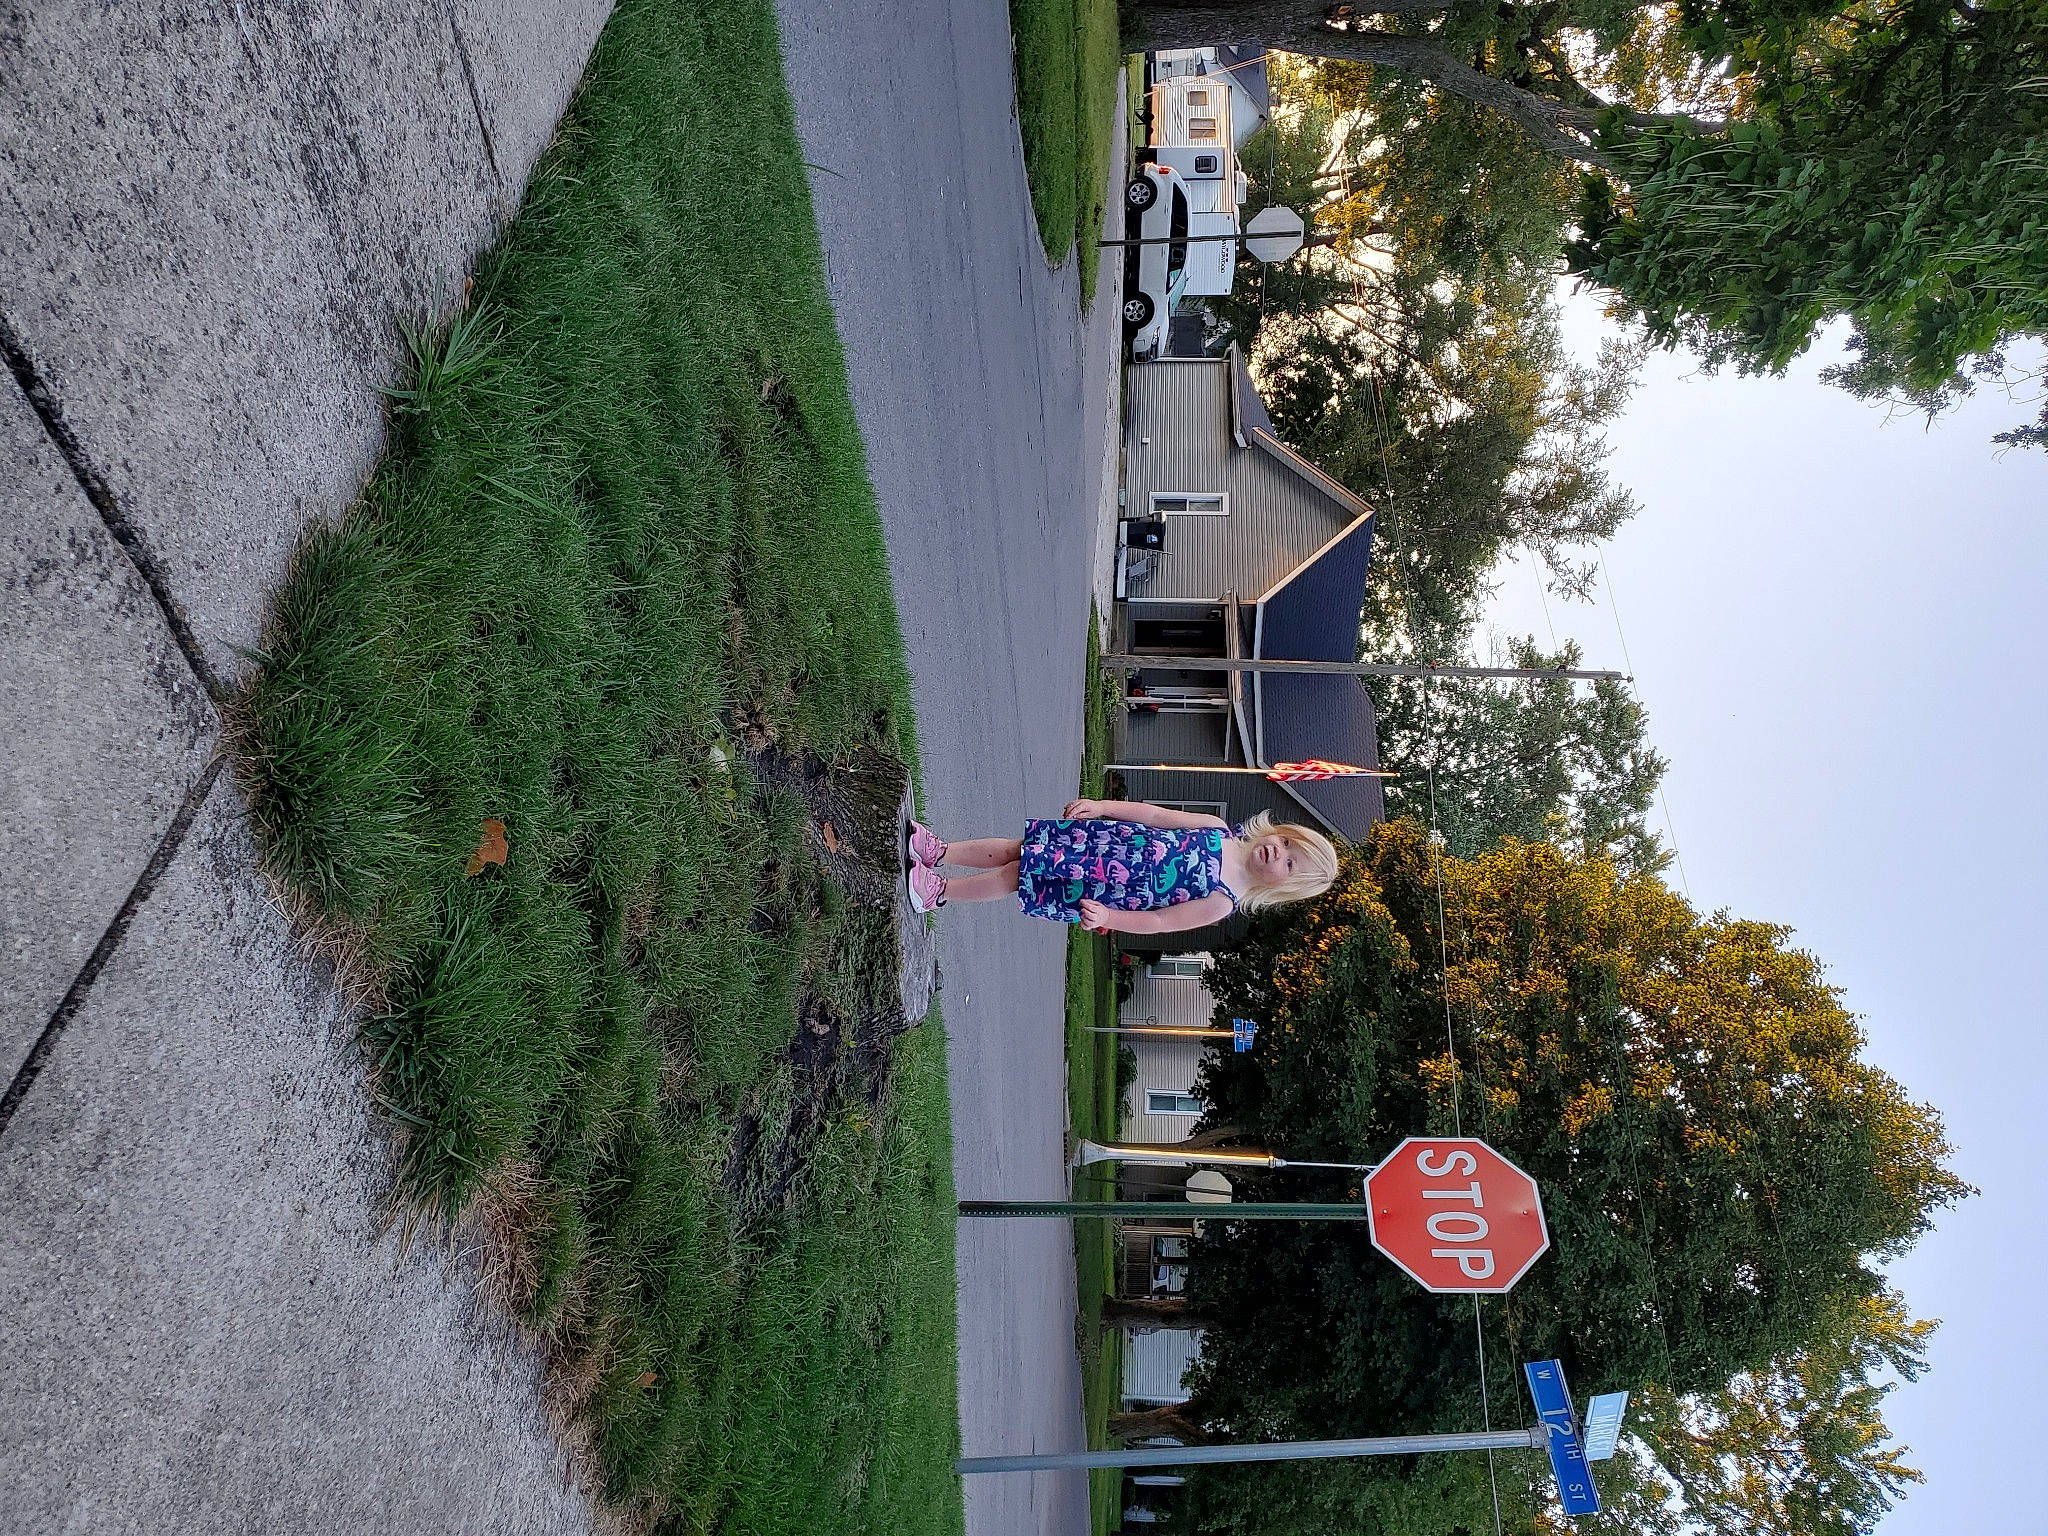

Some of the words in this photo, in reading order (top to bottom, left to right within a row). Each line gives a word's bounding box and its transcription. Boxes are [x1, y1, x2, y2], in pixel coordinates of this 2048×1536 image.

[1416, 1149, 1495, 1280] STOP
[1536, 1369, 1552, 1379] W
[1568, 1483, 1586, 1501] ST
